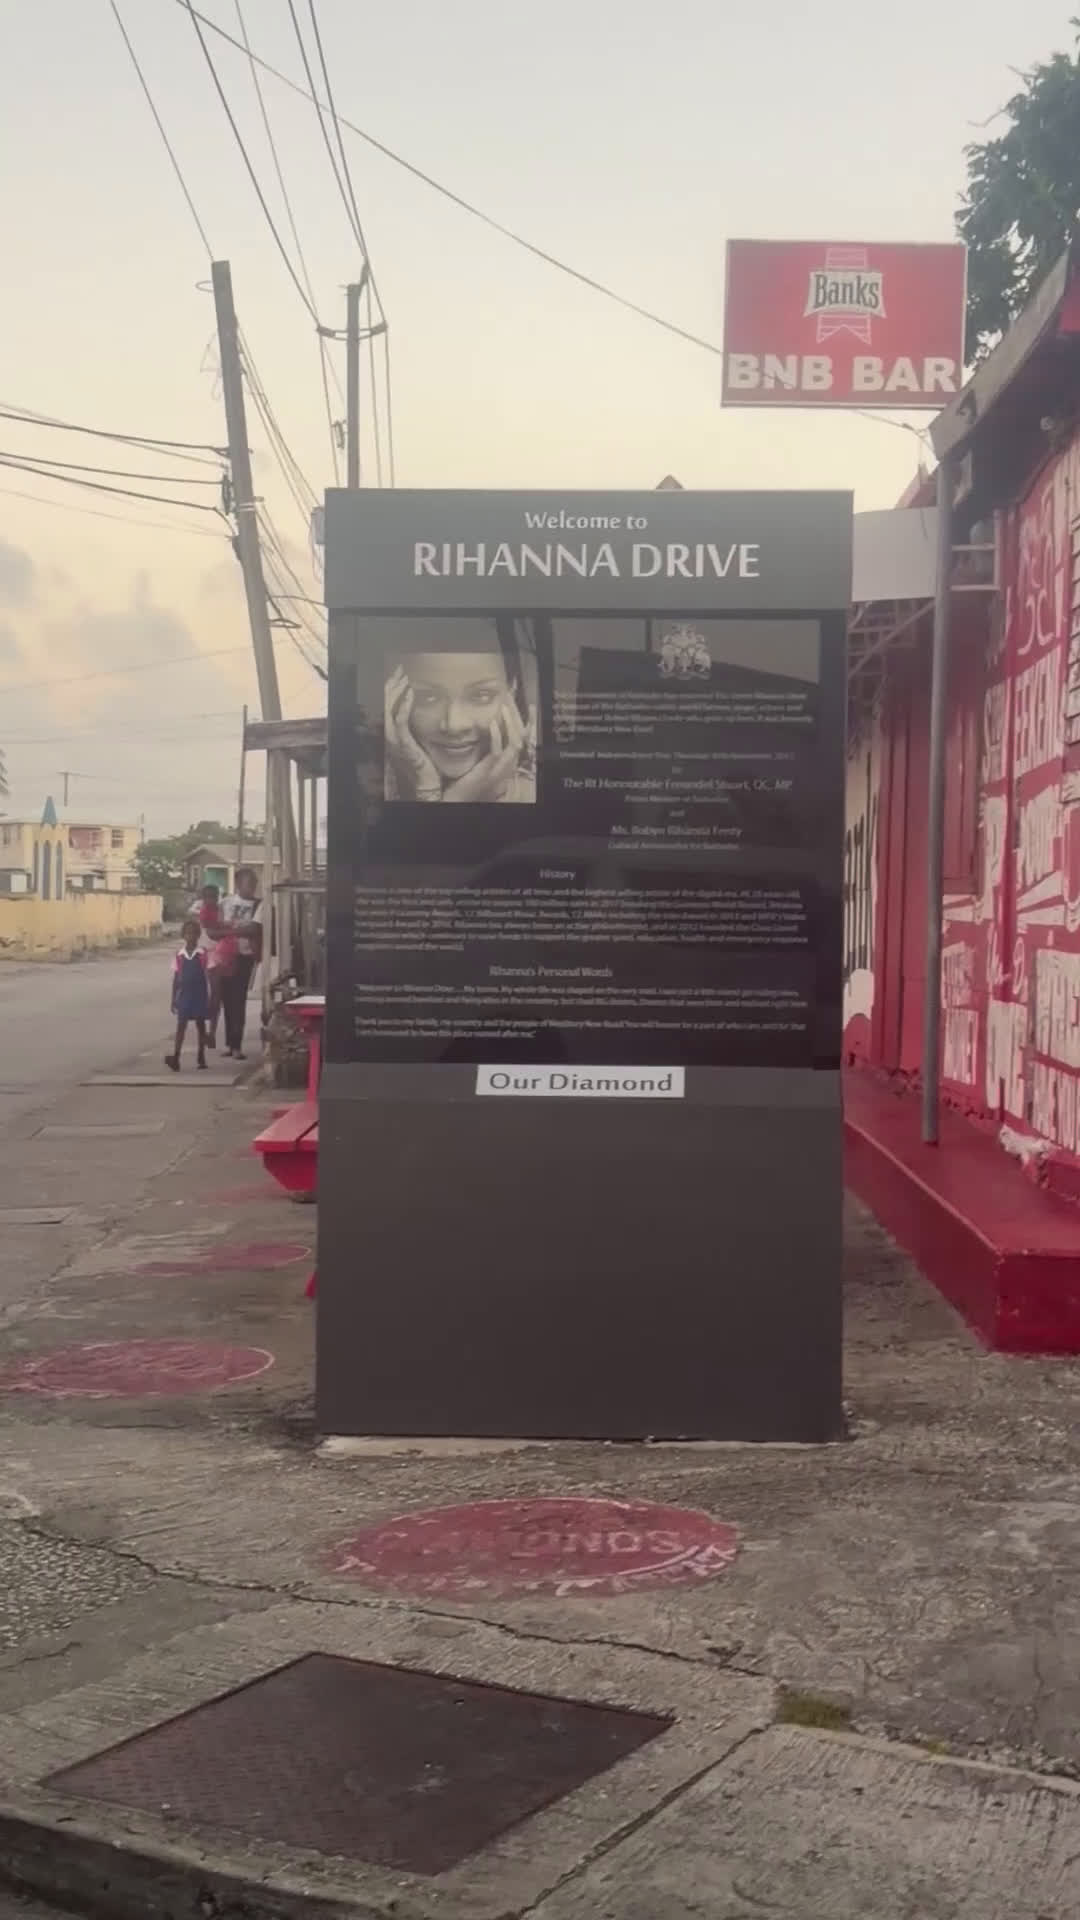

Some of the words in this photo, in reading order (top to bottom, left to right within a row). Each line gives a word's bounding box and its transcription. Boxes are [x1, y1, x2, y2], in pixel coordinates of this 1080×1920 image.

[813, 273, 880, 310] Banks
[727, 353, 834, 391] BNB
[852, 355, 957, 392] BAR
[524, 510, 621, 530] Welcome
[626, 513, 649, 530] to
[414, 542, 621, 577] RIHANNA
[631, 543, 761, 578] DRIVE
[539, 868, 577, 881] History
[489, 1072, 541, 1090] Our
[549, 1073, 673, 1092] Diamond
